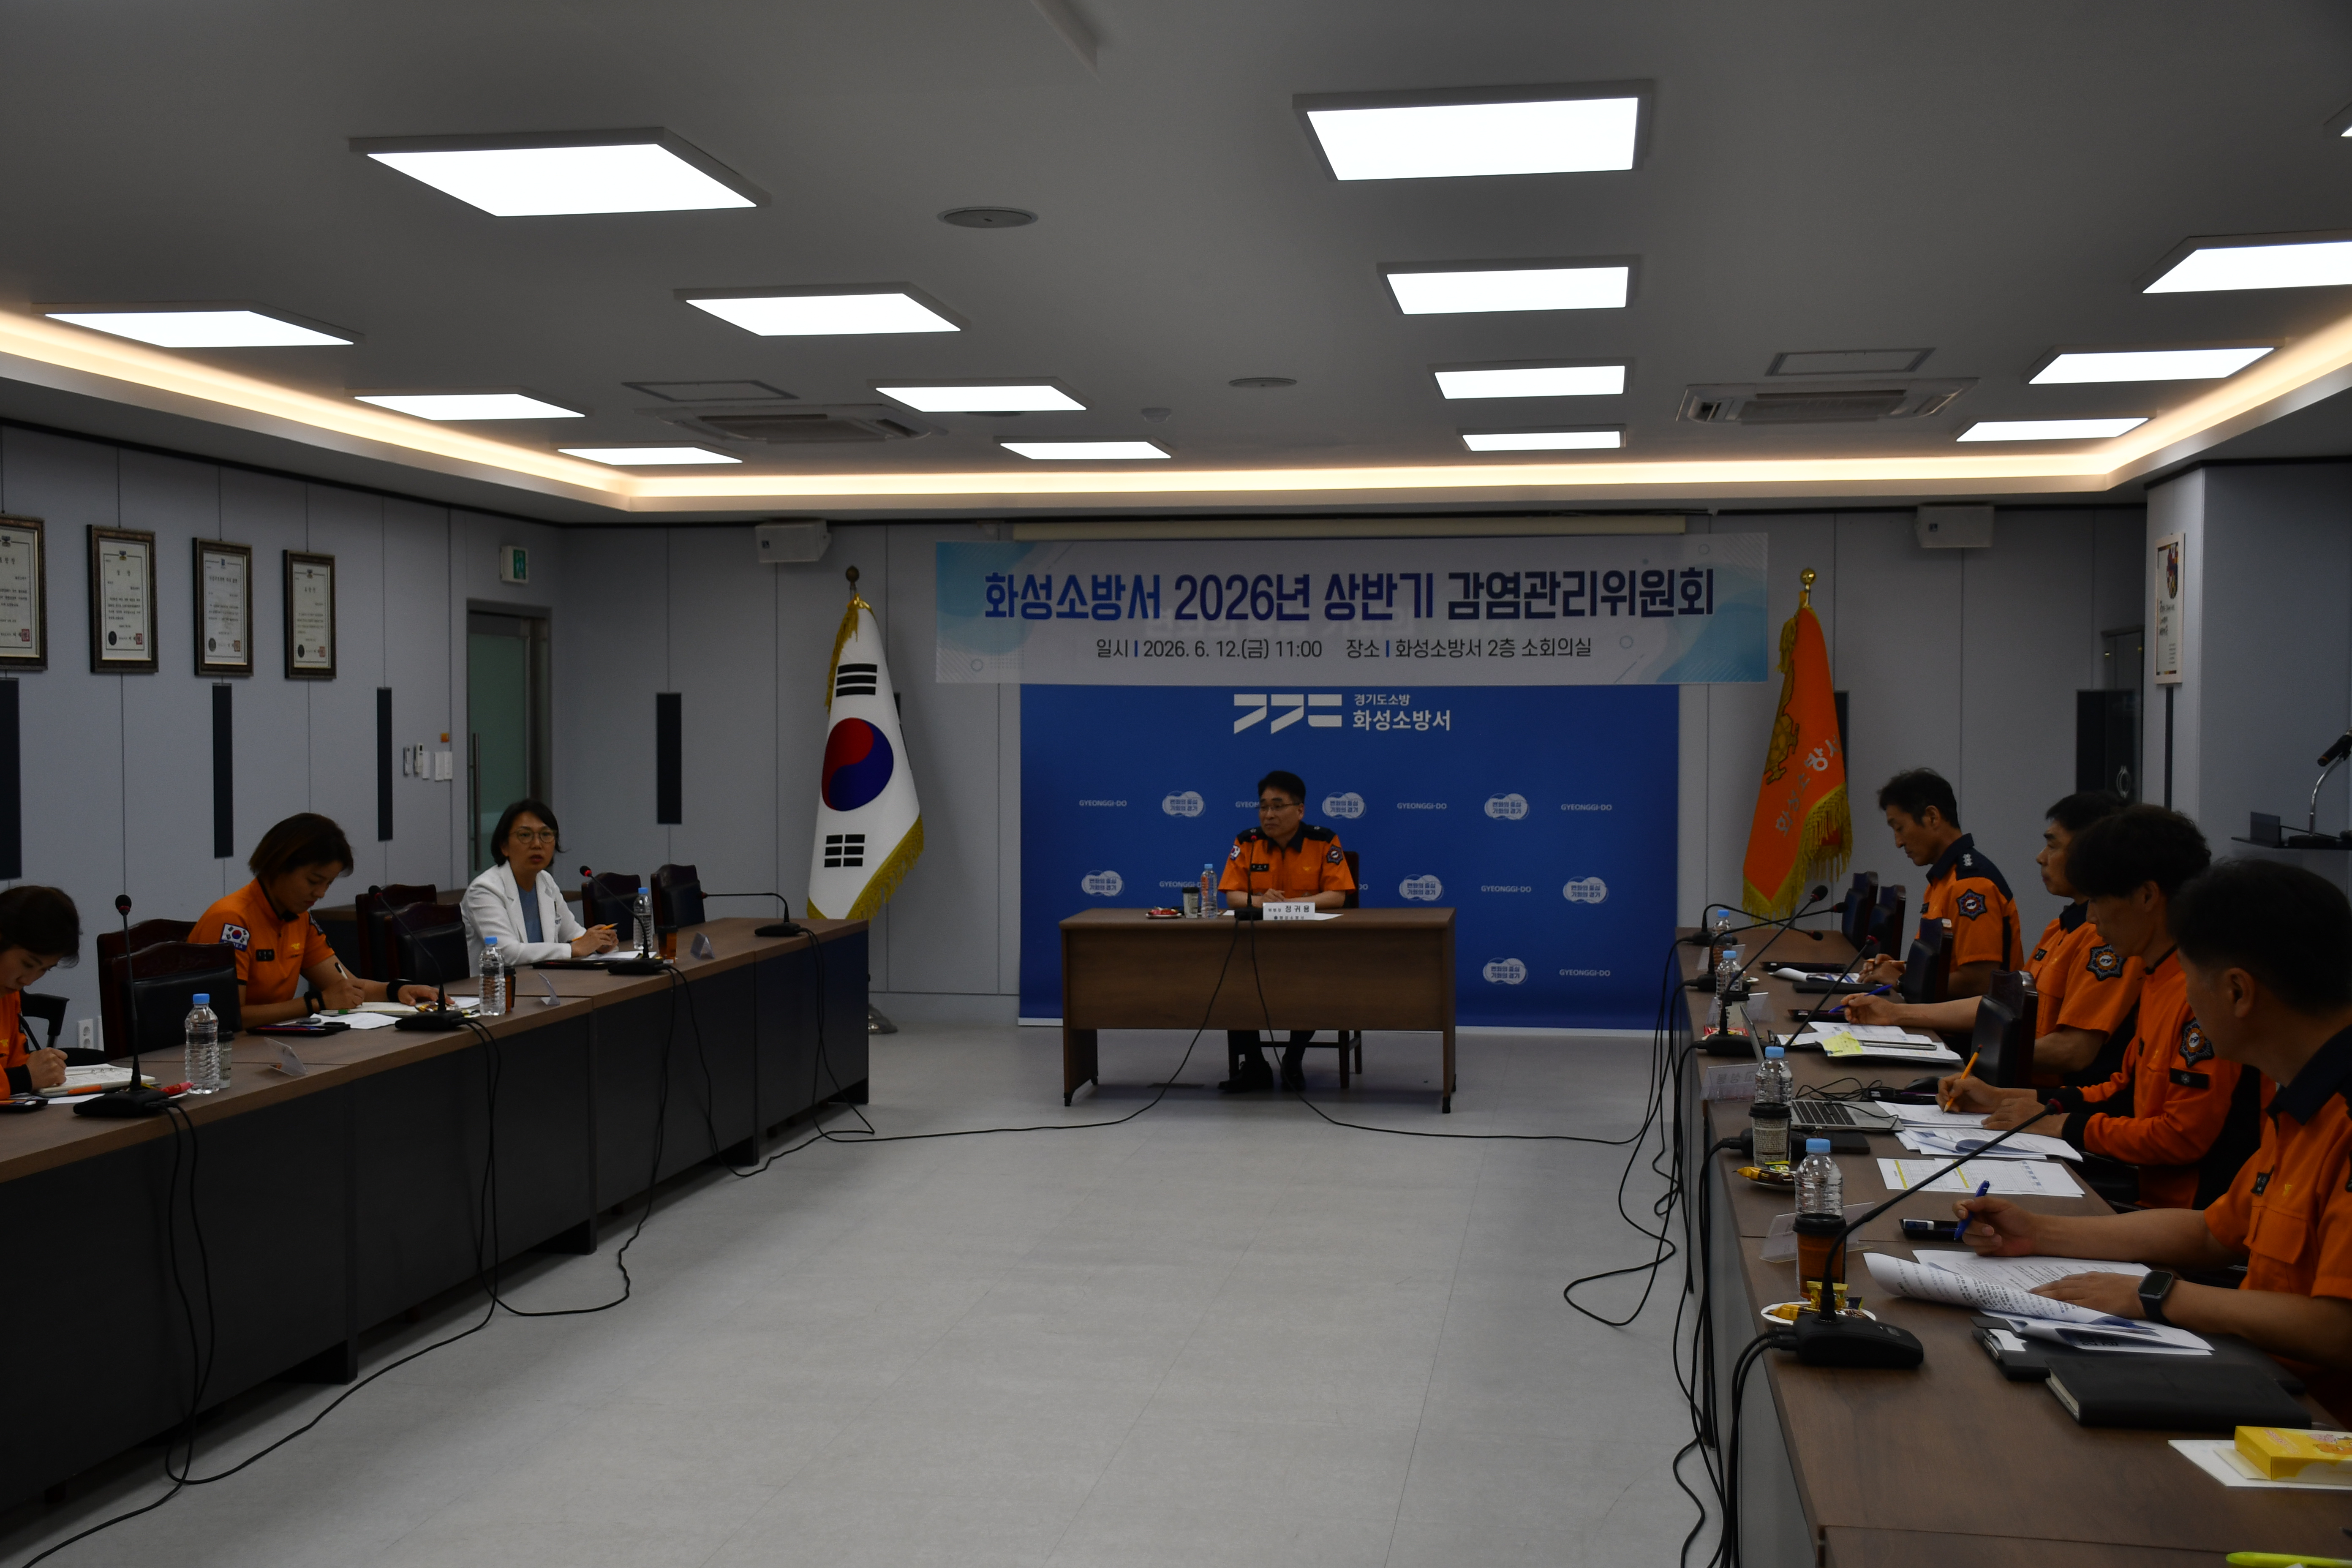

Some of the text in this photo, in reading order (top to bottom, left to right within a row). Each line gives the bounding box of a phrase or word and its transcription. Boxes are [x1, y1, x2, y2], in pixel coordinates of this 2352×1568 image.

[985, 568, 1713, 621] 화성소방서 2026년 상반기 감염관리위원회
[1097, 637, 1591, 659] 일시 2026. 6. 12.(금) 11:00 장소 화성소방서 2층 소회의실
[1354, 694, 1410, 706] 경기도소방
[1353, 709, 1450, 731] 화성소방서
[1481, 885, 1532, 893] GYEONGGI-DO
[1559, 969, 1611, 977] GYEONGGI-DO
